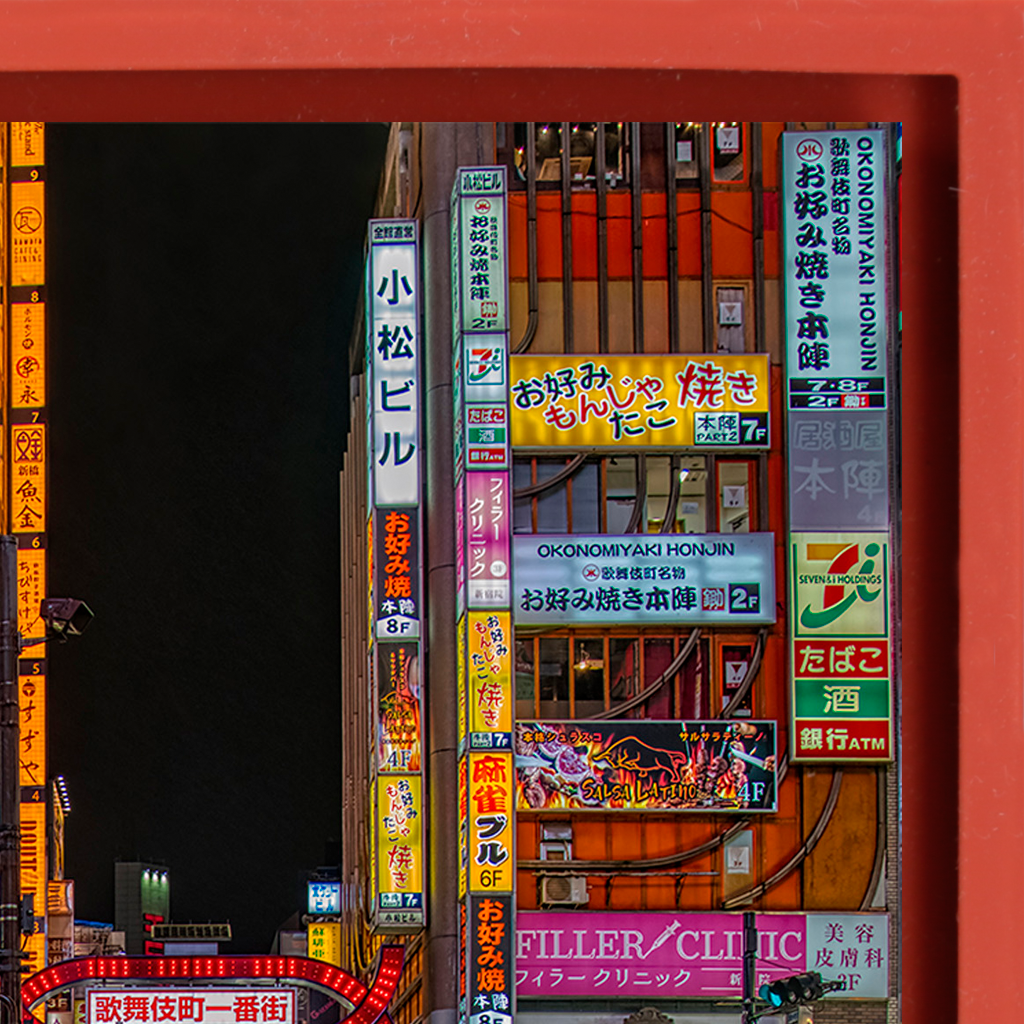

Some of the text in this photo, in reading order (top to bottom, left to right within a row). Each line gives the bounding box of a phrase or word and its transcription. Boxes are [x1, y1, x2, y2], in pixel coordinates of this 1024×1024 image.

[30, 170, 39, 182] 9
[373, 226, 414, 239] 全館直営
[857, 136, 877, 371] OKONOMIYAKI HONJIN
[794, 163, 830, 371] お好み焼き本陣
[31, 291, 40, 303] 8
[471, 319, 499, 329] 2F
[376, 269, 417, 467] 小松ビル
[512, 361, 612, 409] お好み
[676, 360, 759, 410] 焼き
[544, 376, 666, 431] もんじゃ
[807, 395, 839, 407] 2F
[32, 412, 40, 423] 7
[467, 409, 506, 423] たばこ
[607, 399, 678, 441] たこ
[697, 414, 738, 432] 本陣
[740, 419, 767, 441] 7F
[794, 457, 885, 500] 本陣
[489, 478, 503, 540] フィラー
[31, 537, 40, 548] 6
[469, 498, 487, 578] クリニック
[384, 511, 412, 599] お好み焼
[537, 542, 736, 558] OKONOMIYAKI HONJIN
[837, 573, 882, 585] HOLDINGS
[520, 586, 698, 613] お好み焼き本陣
[731, 587, 759, 610] 2F
[385, 618, 411, 634] 8F
[487, 615, 508, 656] お好み
[475, 621, 501, 675] もんじゃ
[798, 645, 884, 674] たばこ
[32, 663, 40, 675] 5
[471, 653, 489, 679] たこ
[477, 682, 505, 728] 焼き
[823, 685, 861, 713] 酒
[494, 733, 509, 747] 7F
[523, 732, 603, 743] 本格シュラスコ
[800, 727, 885, 750] 銀行ATM
[387, 750, 411, 768] 4F
[31, 790, 40, 801] 4
[398, 779, 418, 819] お好み
[580, 778, 631, 802] SALSA
[738, 782, 766, 802] 4F
[385, 785, 411, 838] もんじゃ
[382, 816, 398, 842] たこ
[387, 844, 414, 890] 焼き
[480, 870, 503, 888] 6F
[404, 893, 418, 907] 7F
[514, 929, 646, 960] FILLER
[824, 923, 875, 944] 美容
[477, 898, 507, 993] お好み焼
[814, 947, 885, 969] 皮膚科
[514, 968, 691, 989] フィラー クリニック
[729, 973, 772, 986] 新院
[95, 995, 288, 1024] 歌舞伎町一番街
